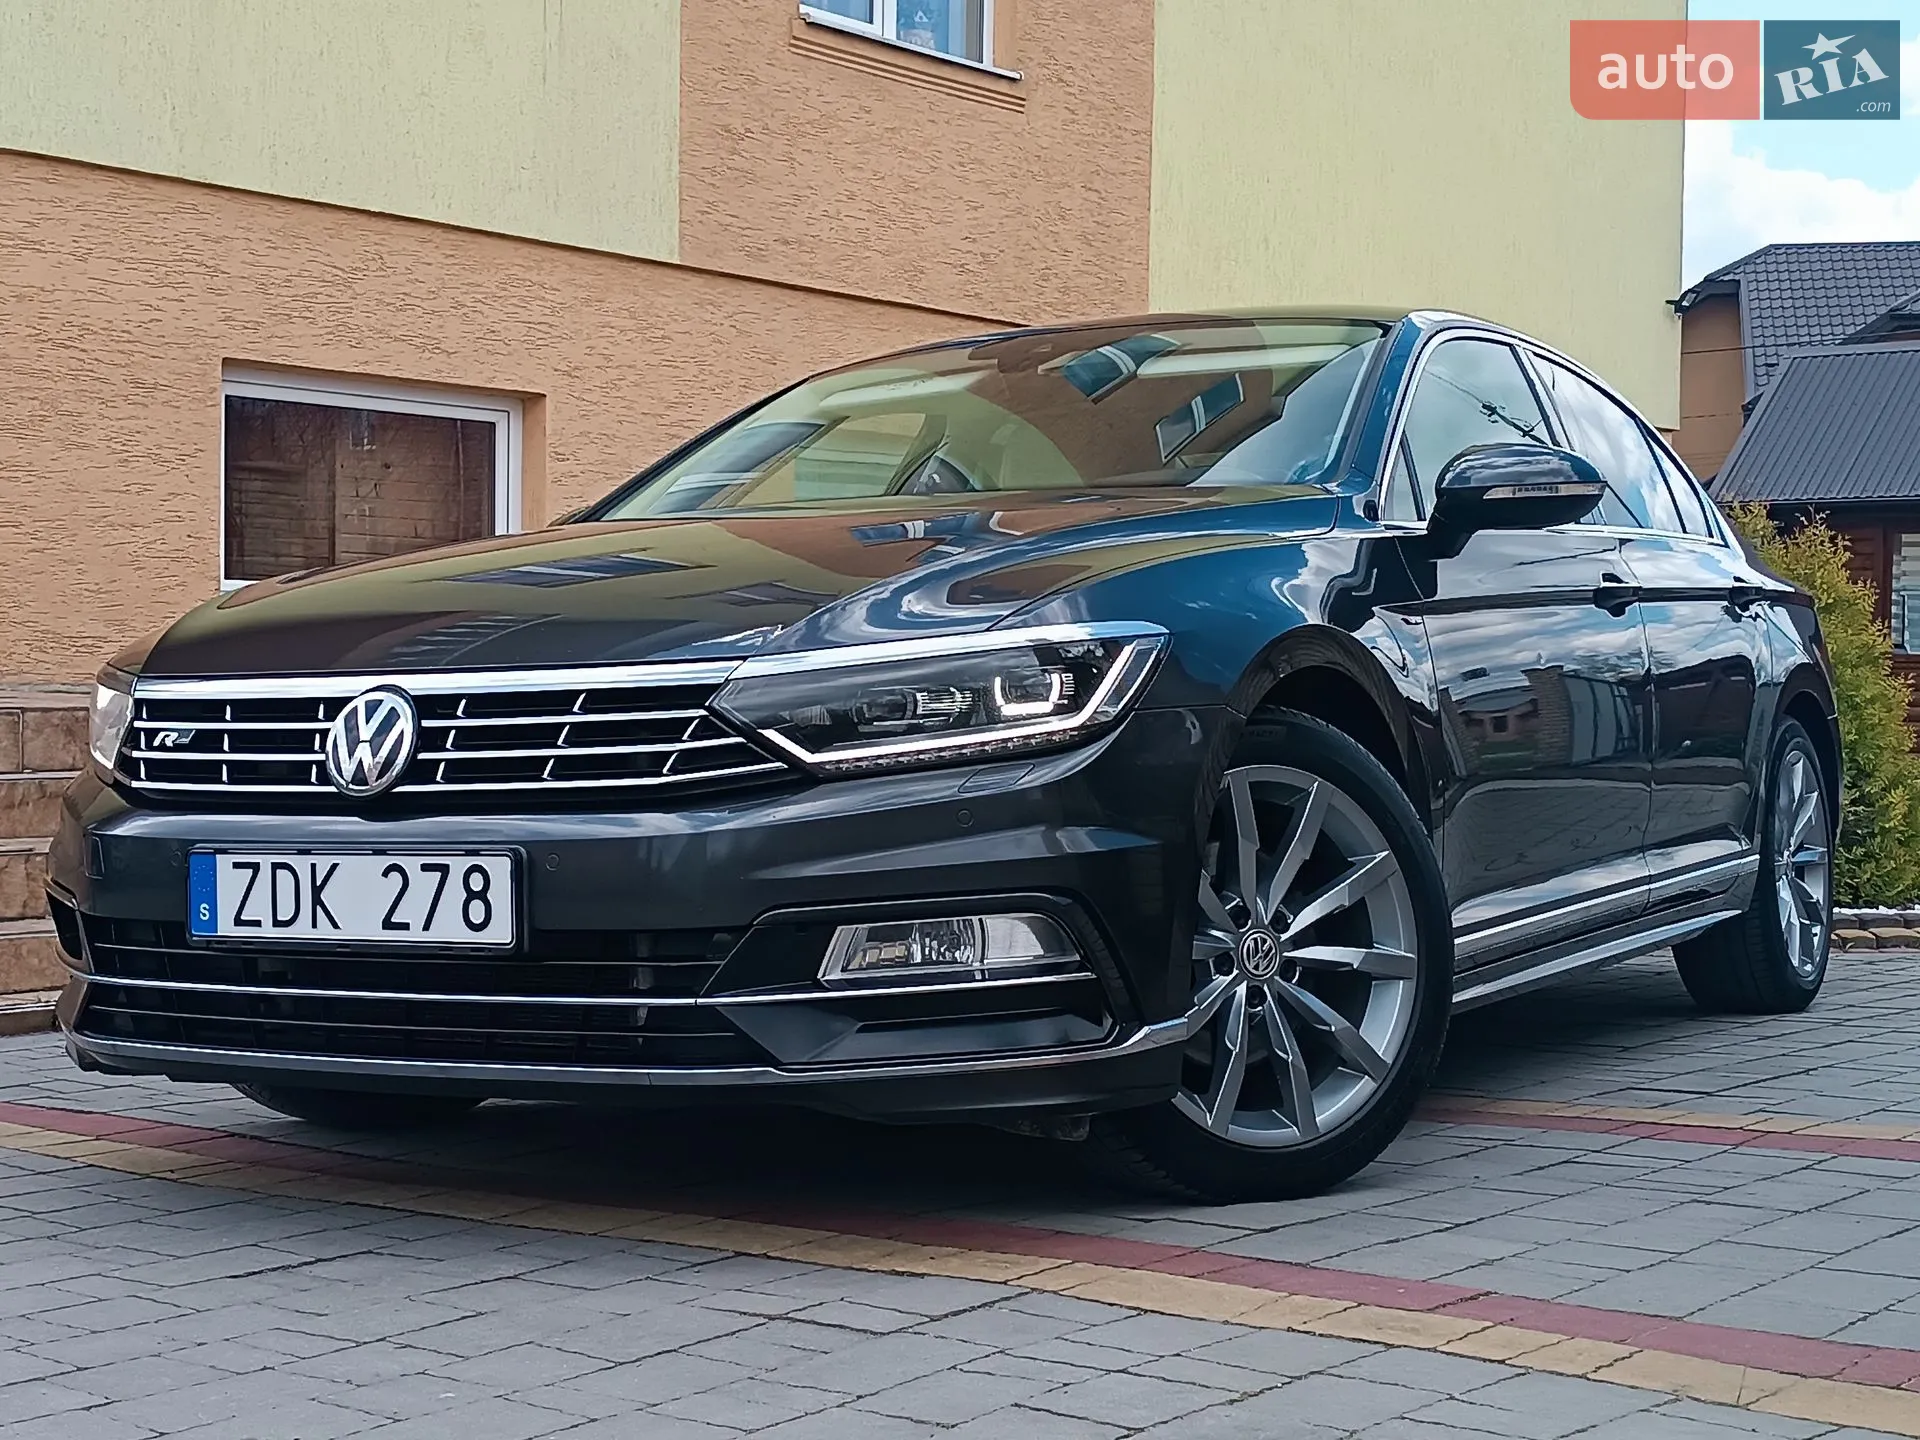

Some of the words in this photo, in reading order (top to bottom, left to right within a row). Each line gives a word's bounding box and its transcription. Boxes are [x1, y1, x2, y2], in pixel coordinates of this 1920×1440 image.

[328, 692, 412, 795] VW
[199, 903, 210, 921] S
[231, 861, 342, 930] ZDK
[381, 862, 493, 932] 278
